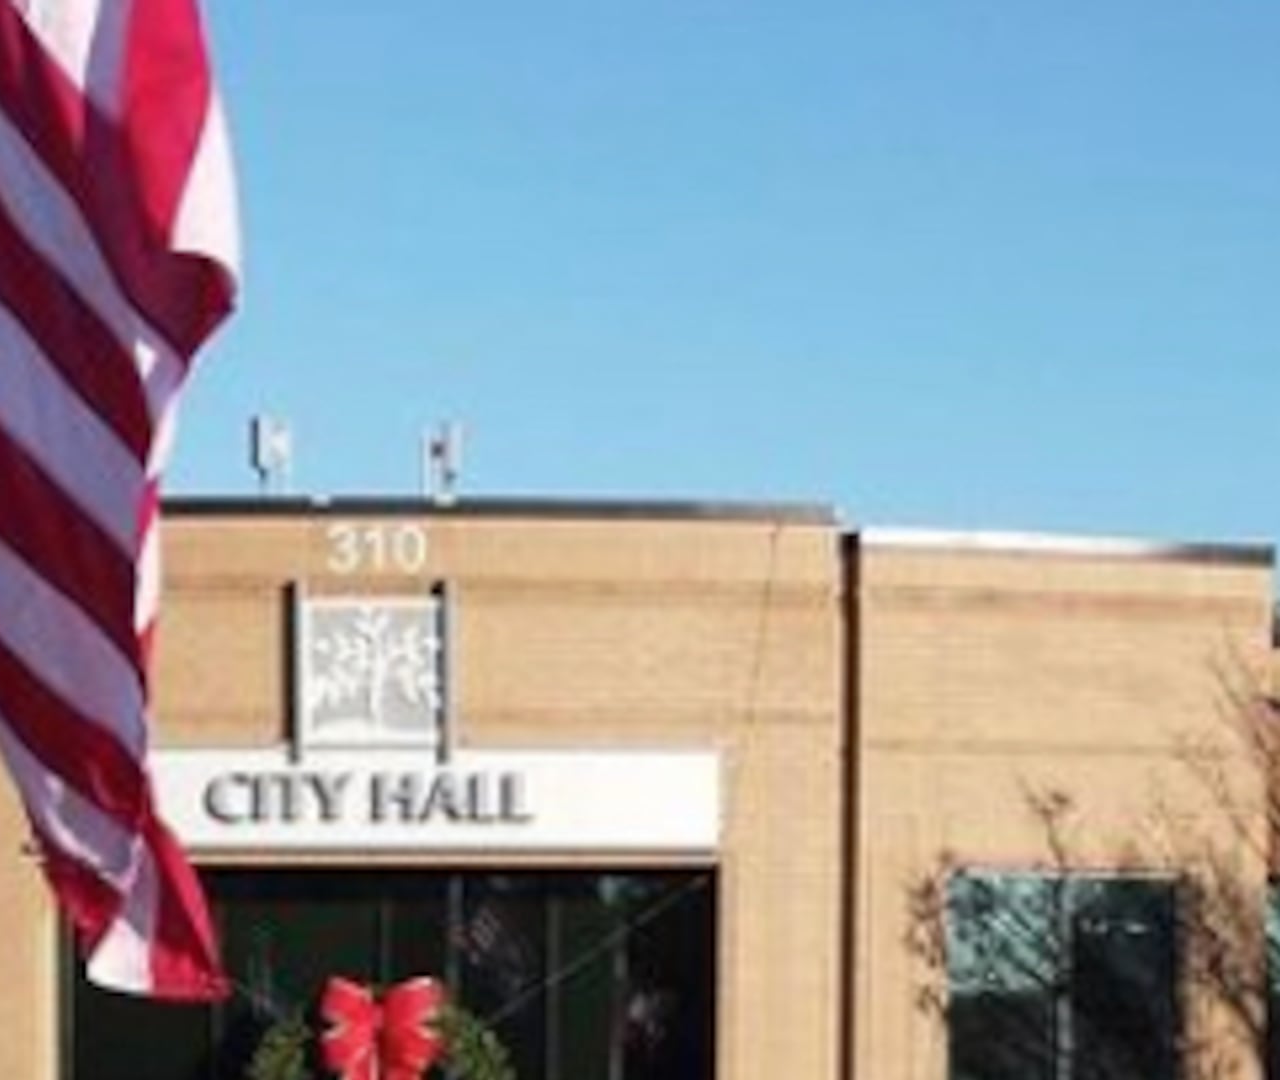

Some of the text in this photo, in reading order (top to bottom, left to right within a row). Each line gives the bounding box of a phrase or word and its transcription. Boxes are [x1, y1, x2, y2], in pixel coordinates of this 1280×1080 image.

[326, 523, 428, 574] 310
[202, 772, 535, 825] CITY HALL
